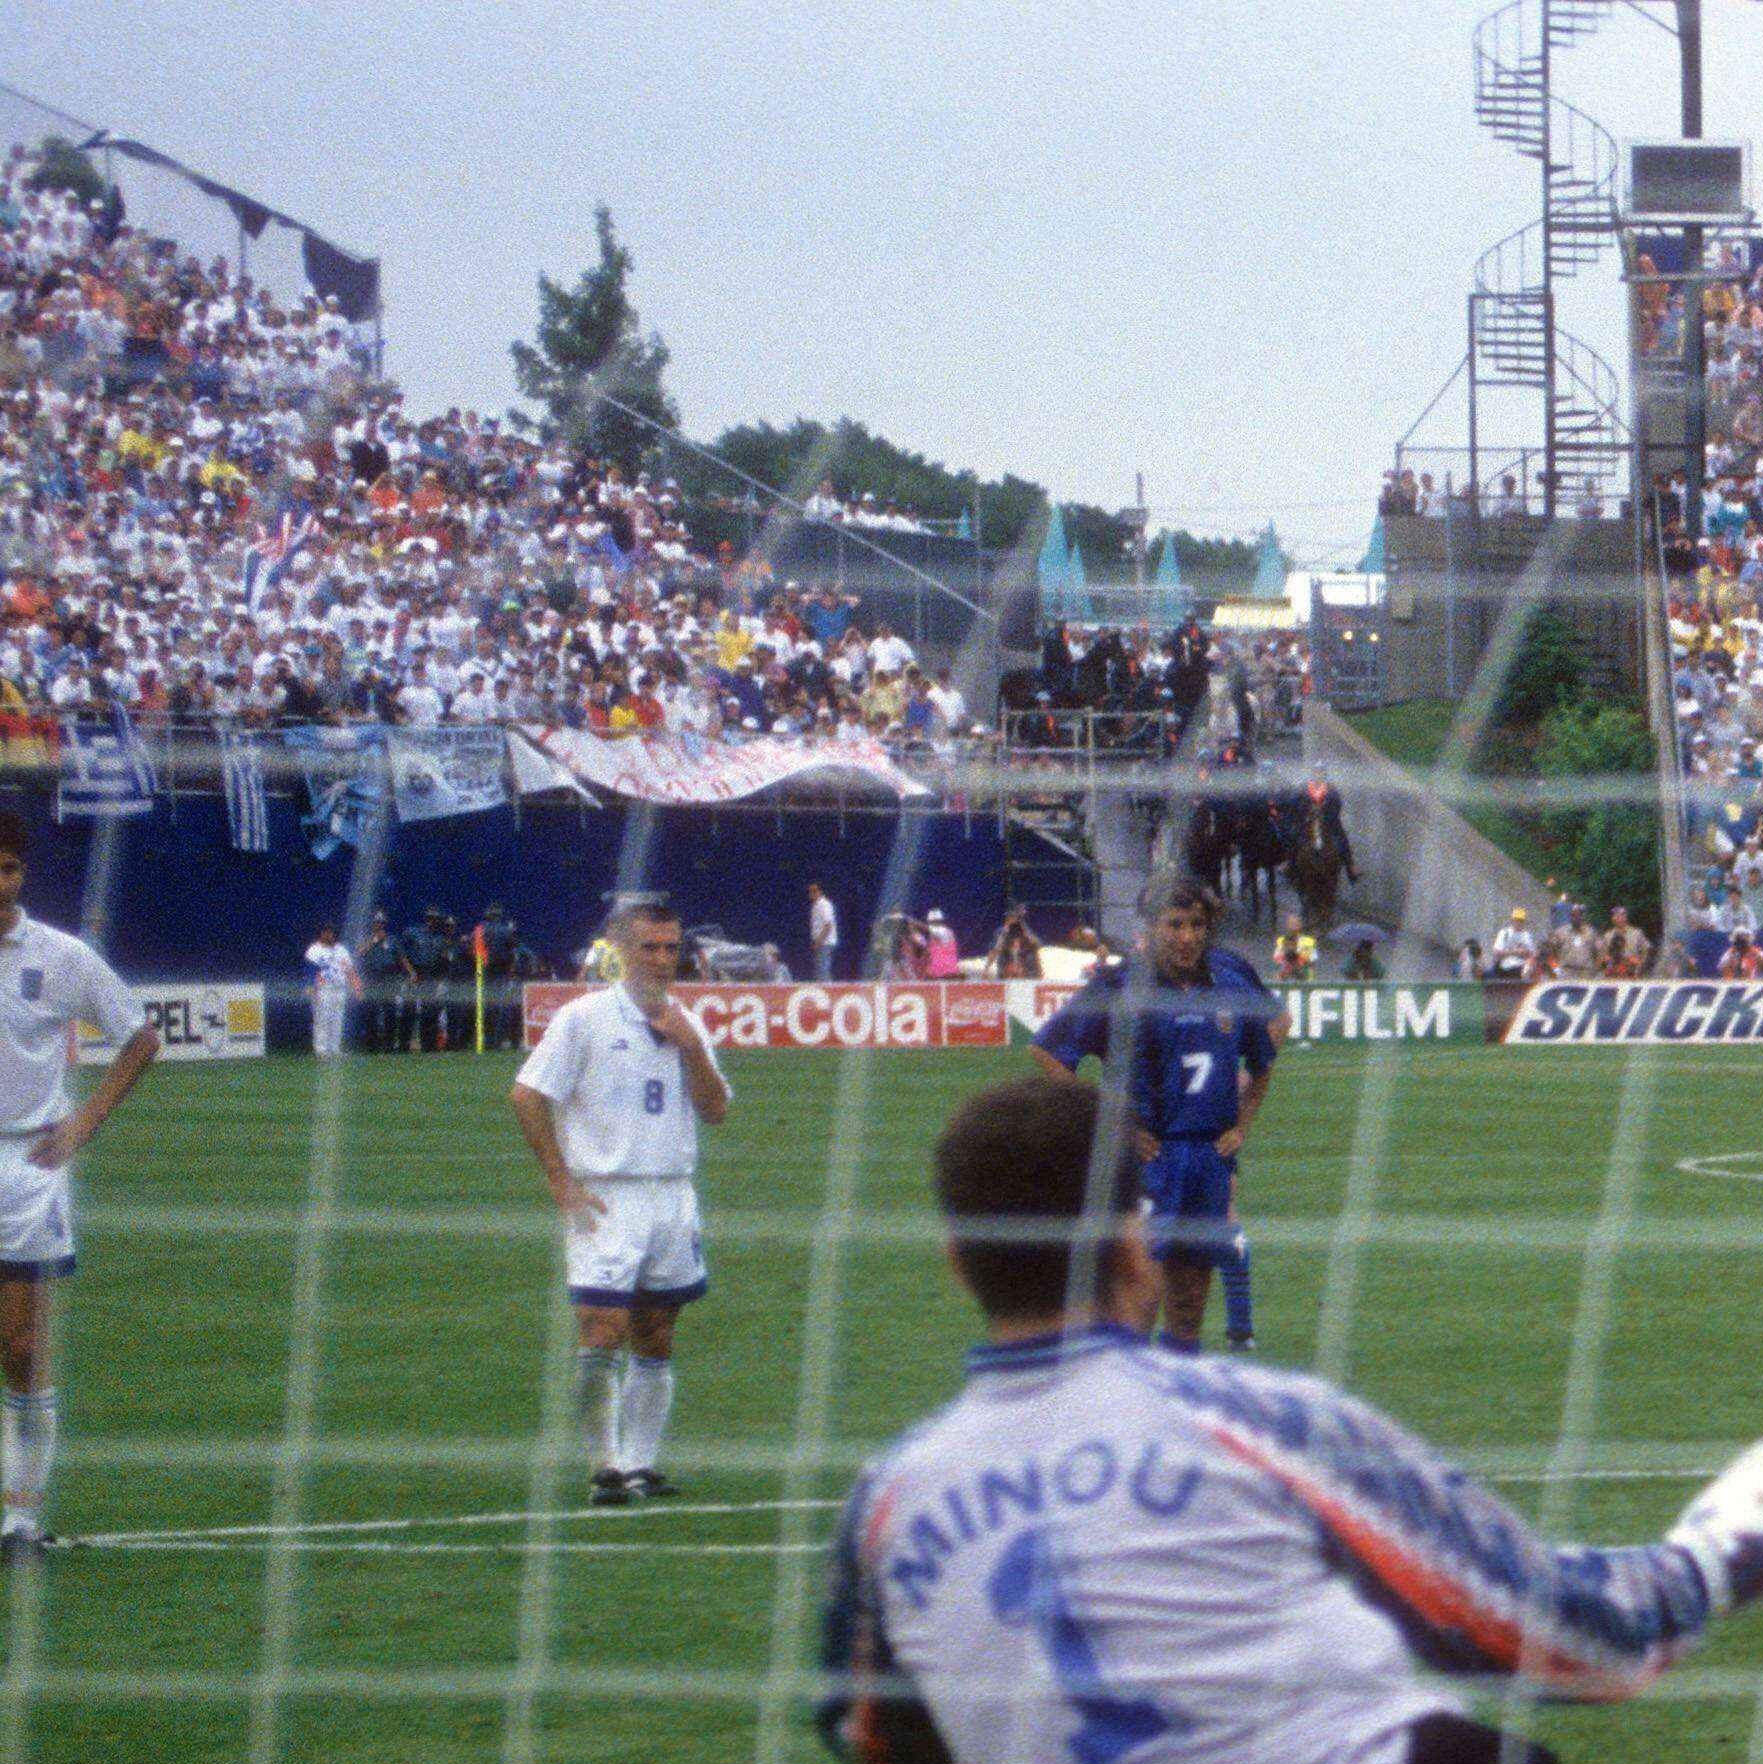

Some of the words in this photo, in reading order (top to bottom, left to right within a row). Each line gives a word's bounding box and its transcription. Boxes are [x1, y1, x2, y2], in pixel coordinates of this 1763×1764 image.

[142, 1000, 203, 1044] PEL
[695, 986, 931, 1046] ca-Cola
[1287, 989, 1451, 1039] IFILM
[1180, 1051, 1213, 1095] 7
[644, 1079, 665, 1115] 8
[887, 1438, 1202, 1605] MINOU
